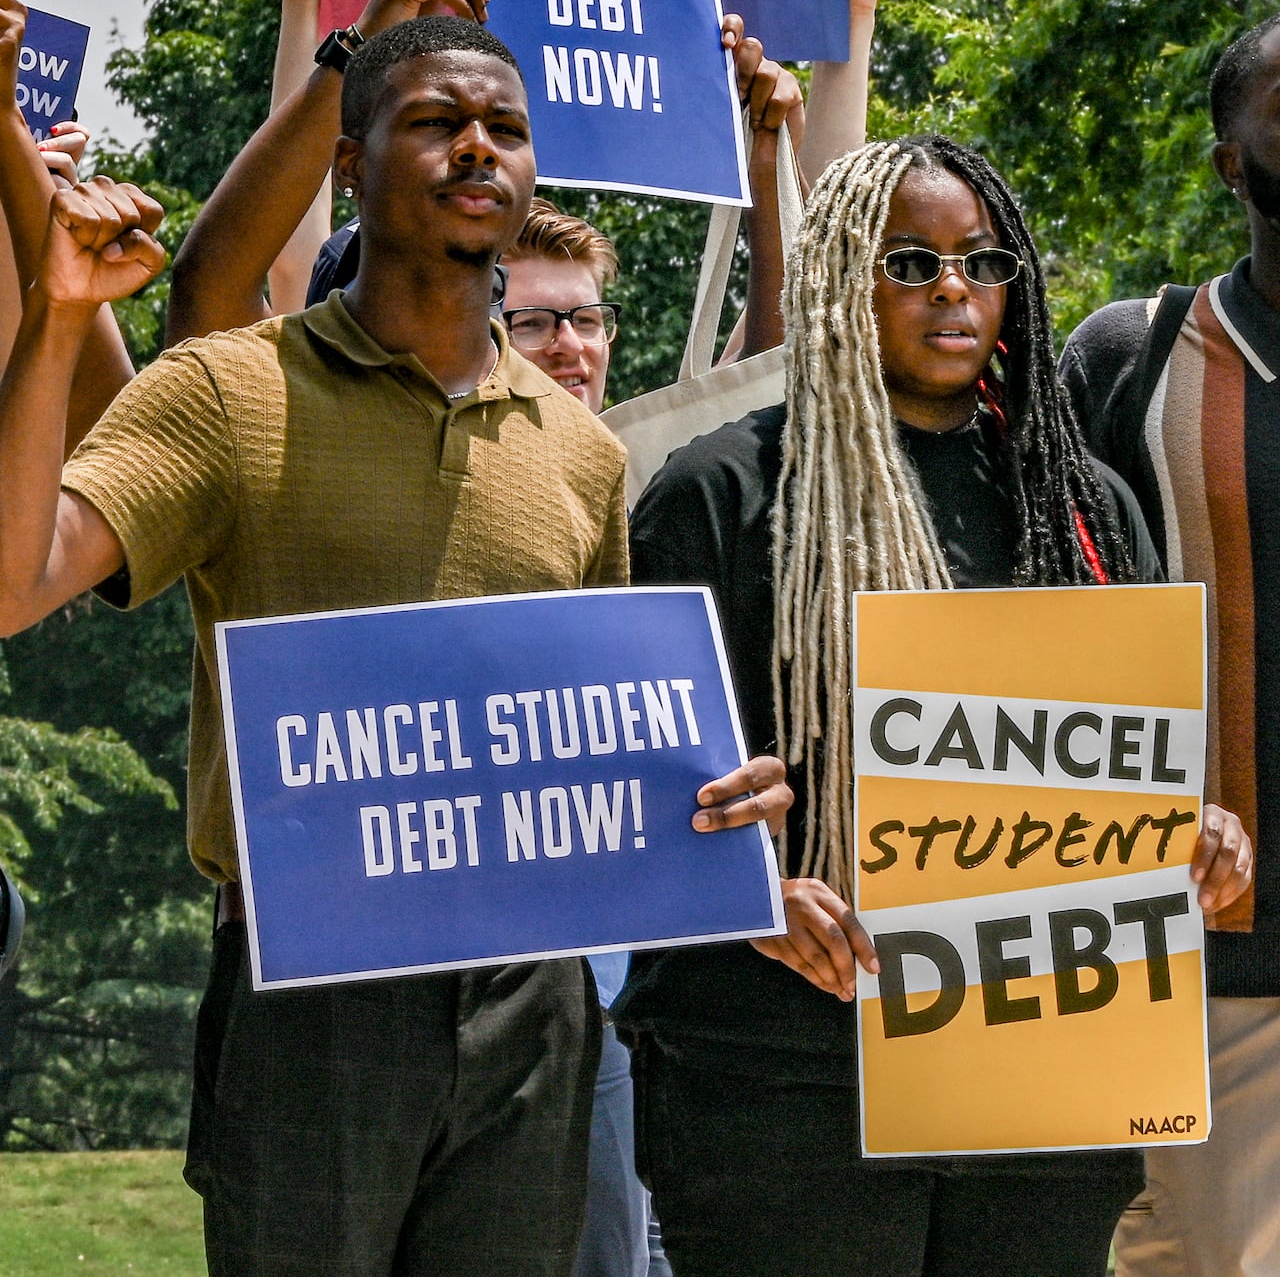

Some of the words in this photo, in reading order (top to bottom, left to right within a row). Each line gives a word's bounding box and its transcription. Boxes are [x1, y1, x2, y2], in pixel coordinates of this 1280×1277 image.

[542, 44, 664, 113] NOW!
[276, 698, 474, 788] CANCEL
[485, 678, 703, 767] STUDENT
[869, 697, 1187, 784] CANCEL
[359, 795, 483, 878] DEBT
[502, 778, 646, 863] NOW!
[860, 811, 1197, 875] STUDENT
[873, 891, 1191, 1040] DEBT
[1129, 1115, 1197, 1137] NAACP
